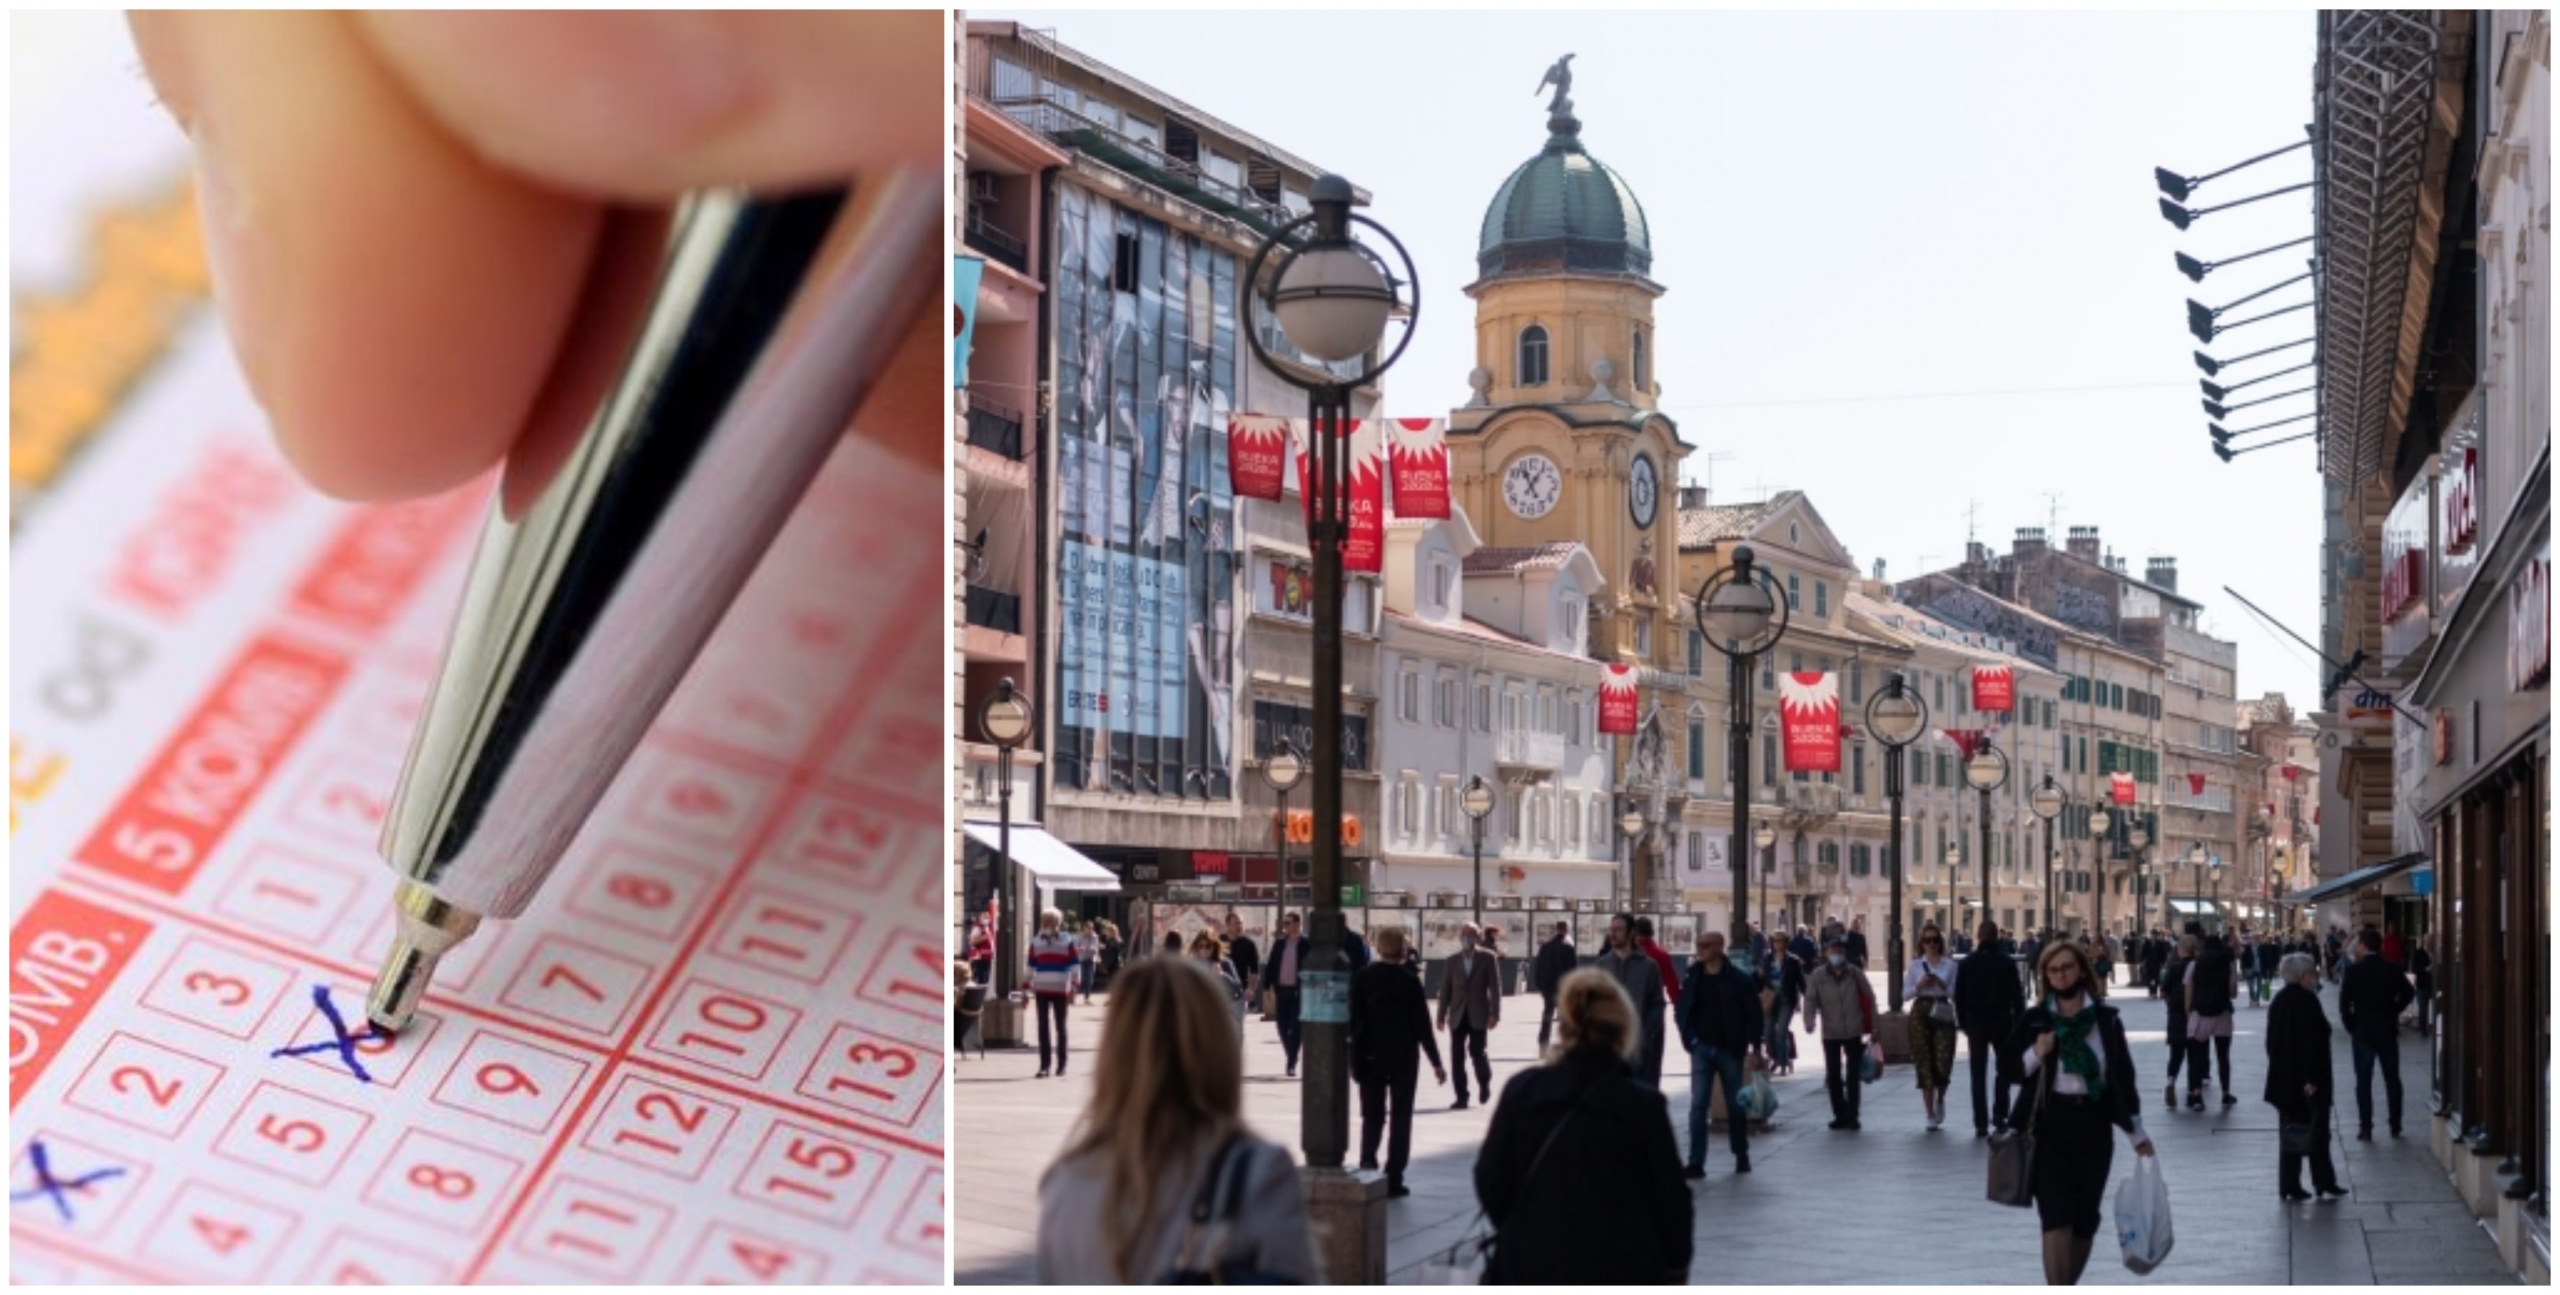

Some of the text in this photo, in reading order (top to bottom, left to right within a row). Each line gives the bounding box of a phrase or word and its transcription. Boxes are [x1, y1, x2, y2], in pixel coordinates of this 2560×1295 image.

[2355, 689, 2392, 708] dm
[111, 821, 196, 873] 5
[254, 880, 320, 907] 1
[607, 873, 675, 909] 8
[741, 906, 826, 960] 11
[183, 970, 251, 1007] 3
[540, 963, 605, 1001] 7
[677, 995, 767, 1056] 10
[109, 1065, 184, 1107] 2
[474, 1062, 540, 1098] 9
[827, 1042, 917, 1102] 13
[256, 1114, 326, 1154] 5
[613, 1091, 709, 1156] 12
[406, 1163, 476, 1200] 8
[766, 1139, 856, 1202] 15
[190, 1214, 254, 1255] 4
[546, 1199, 639, 1258] 11
